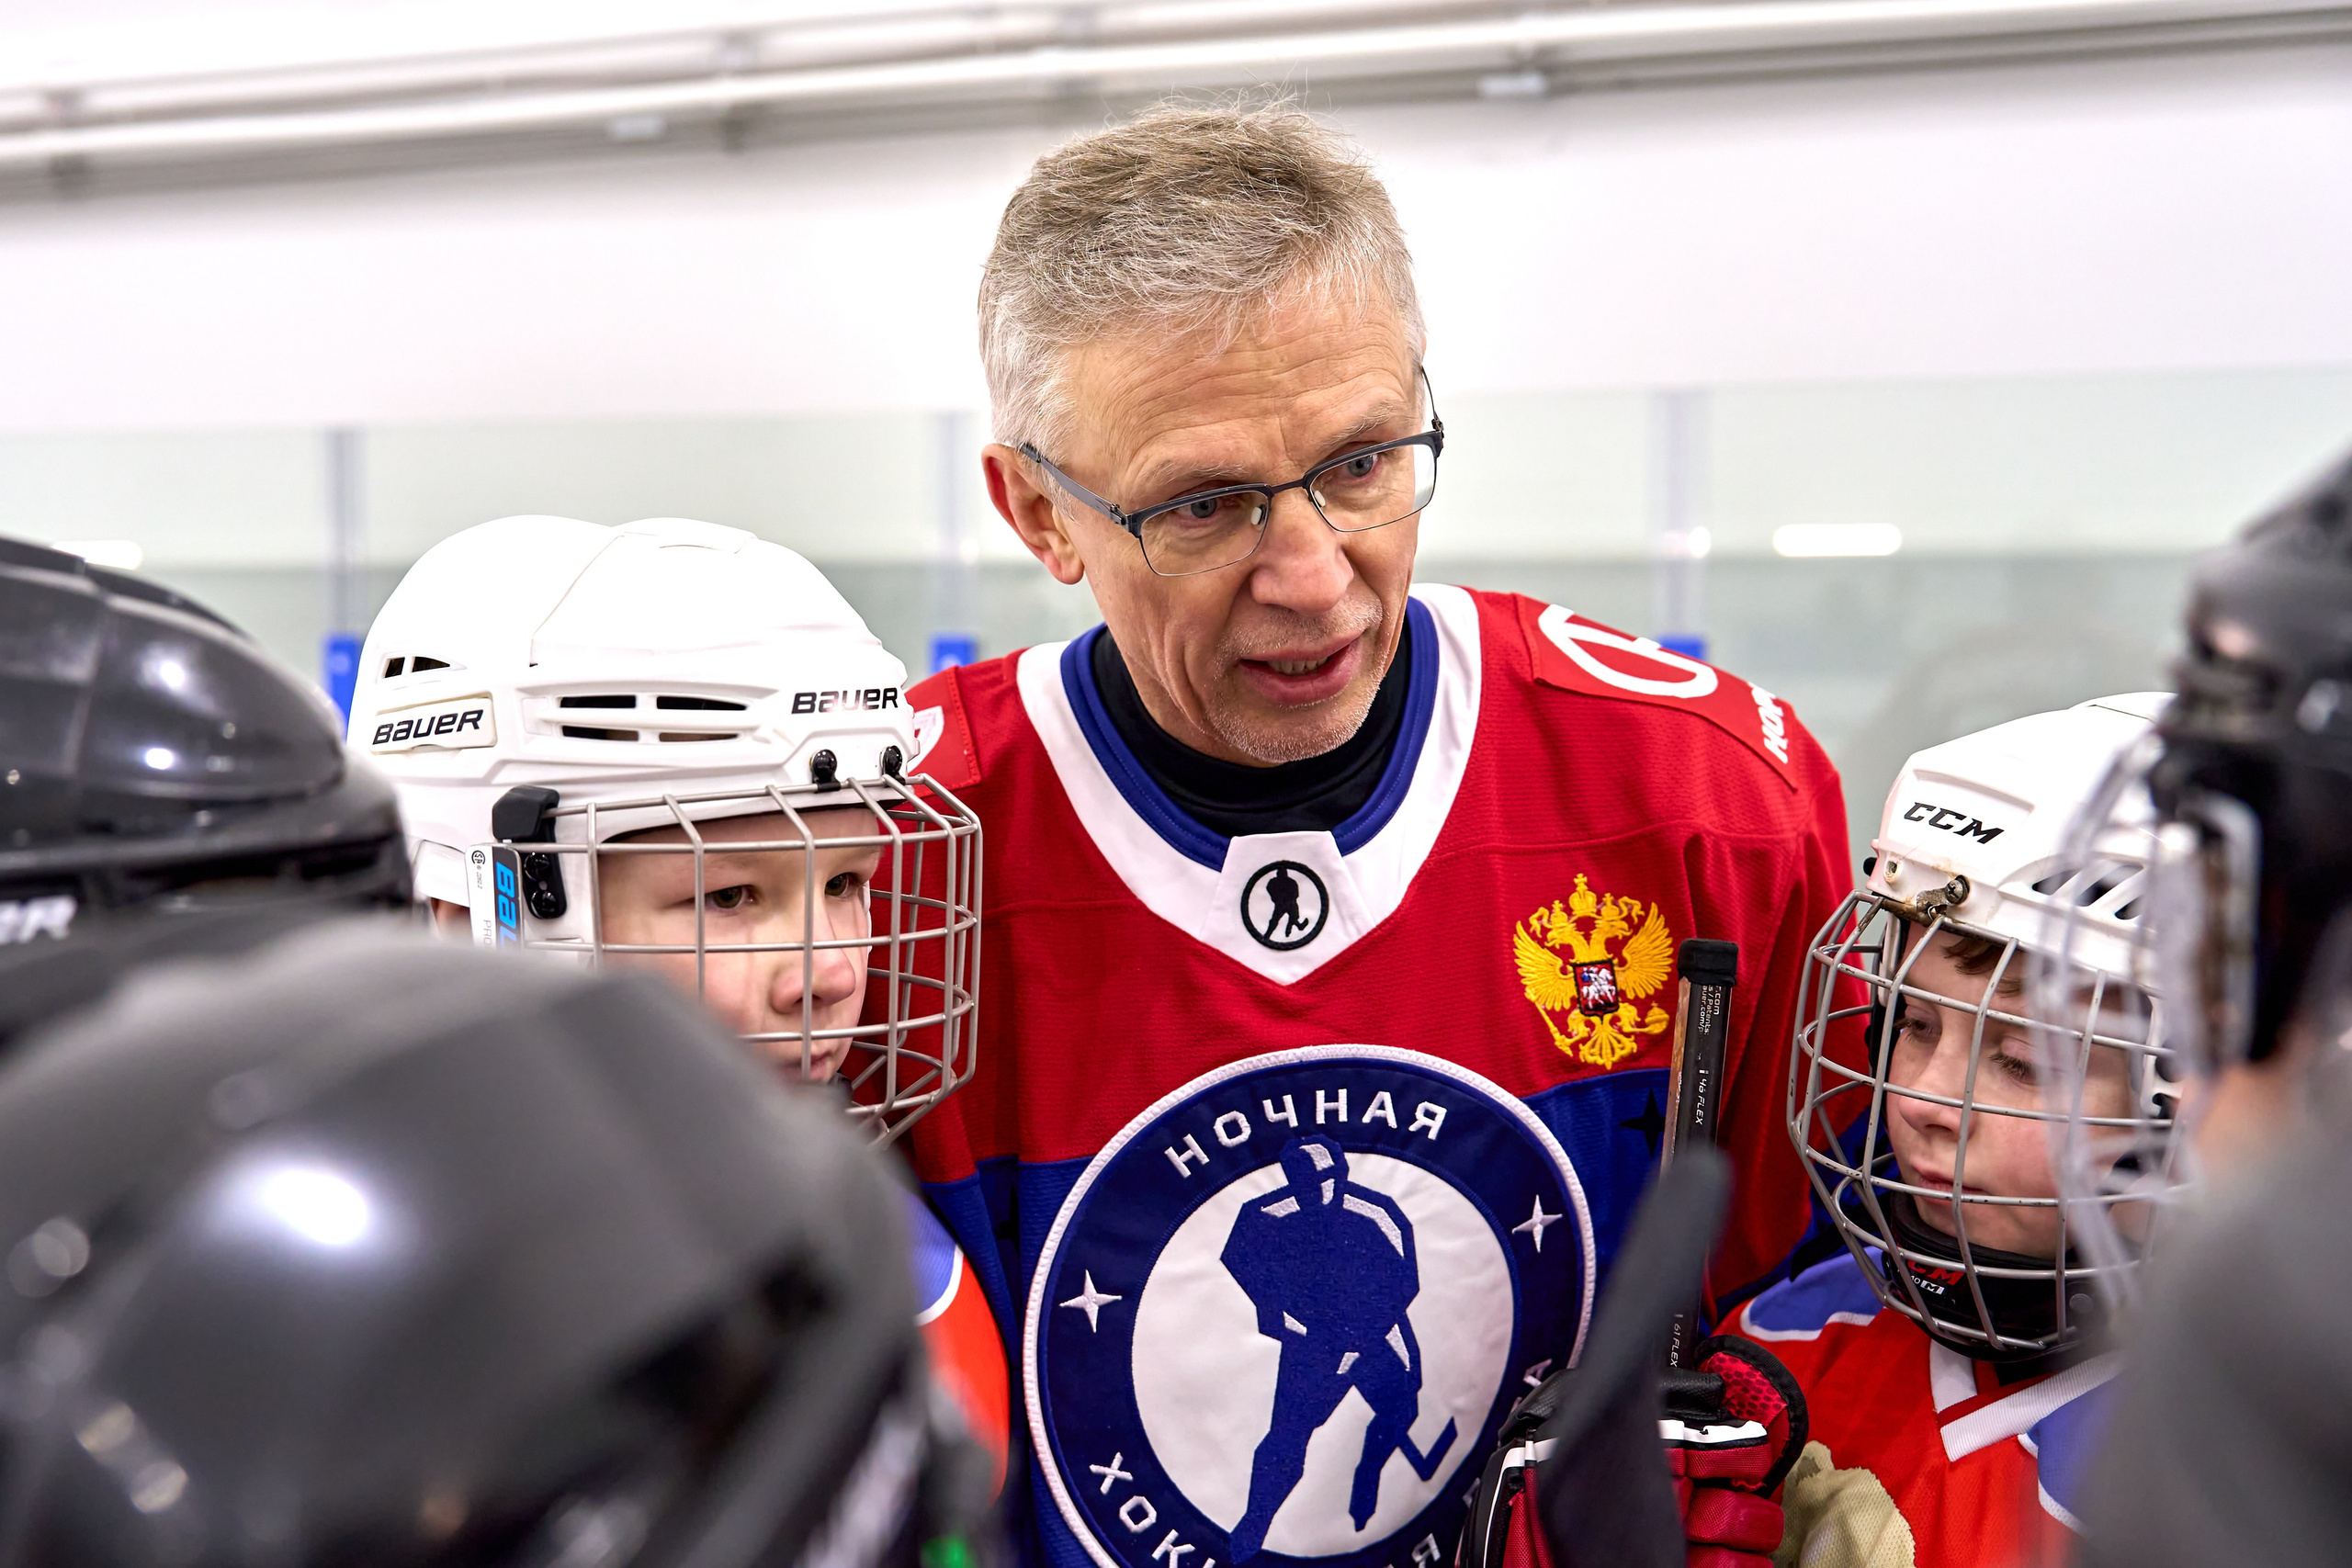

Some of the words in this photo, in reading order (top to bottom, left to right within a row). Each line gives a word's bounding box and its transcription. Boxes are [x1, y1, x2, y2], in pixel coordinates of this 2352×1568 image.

[791, 687, 899, 715] BAUER
[372, 709, 483, 745] BAUER
[1904, 802, 2005, 844] CCM
[1713, 986, 1722, 1015] r.com
[1695, 1095, 1705, 1125] FLEX
[1164, 1088, 1448, 1179] НОЧНАЯ
[1907, 1259, 1965, 1286] CM
[1674, 1324, 1681, 1336] 61
[1670, 1337, 1680, 1368] FLEX
